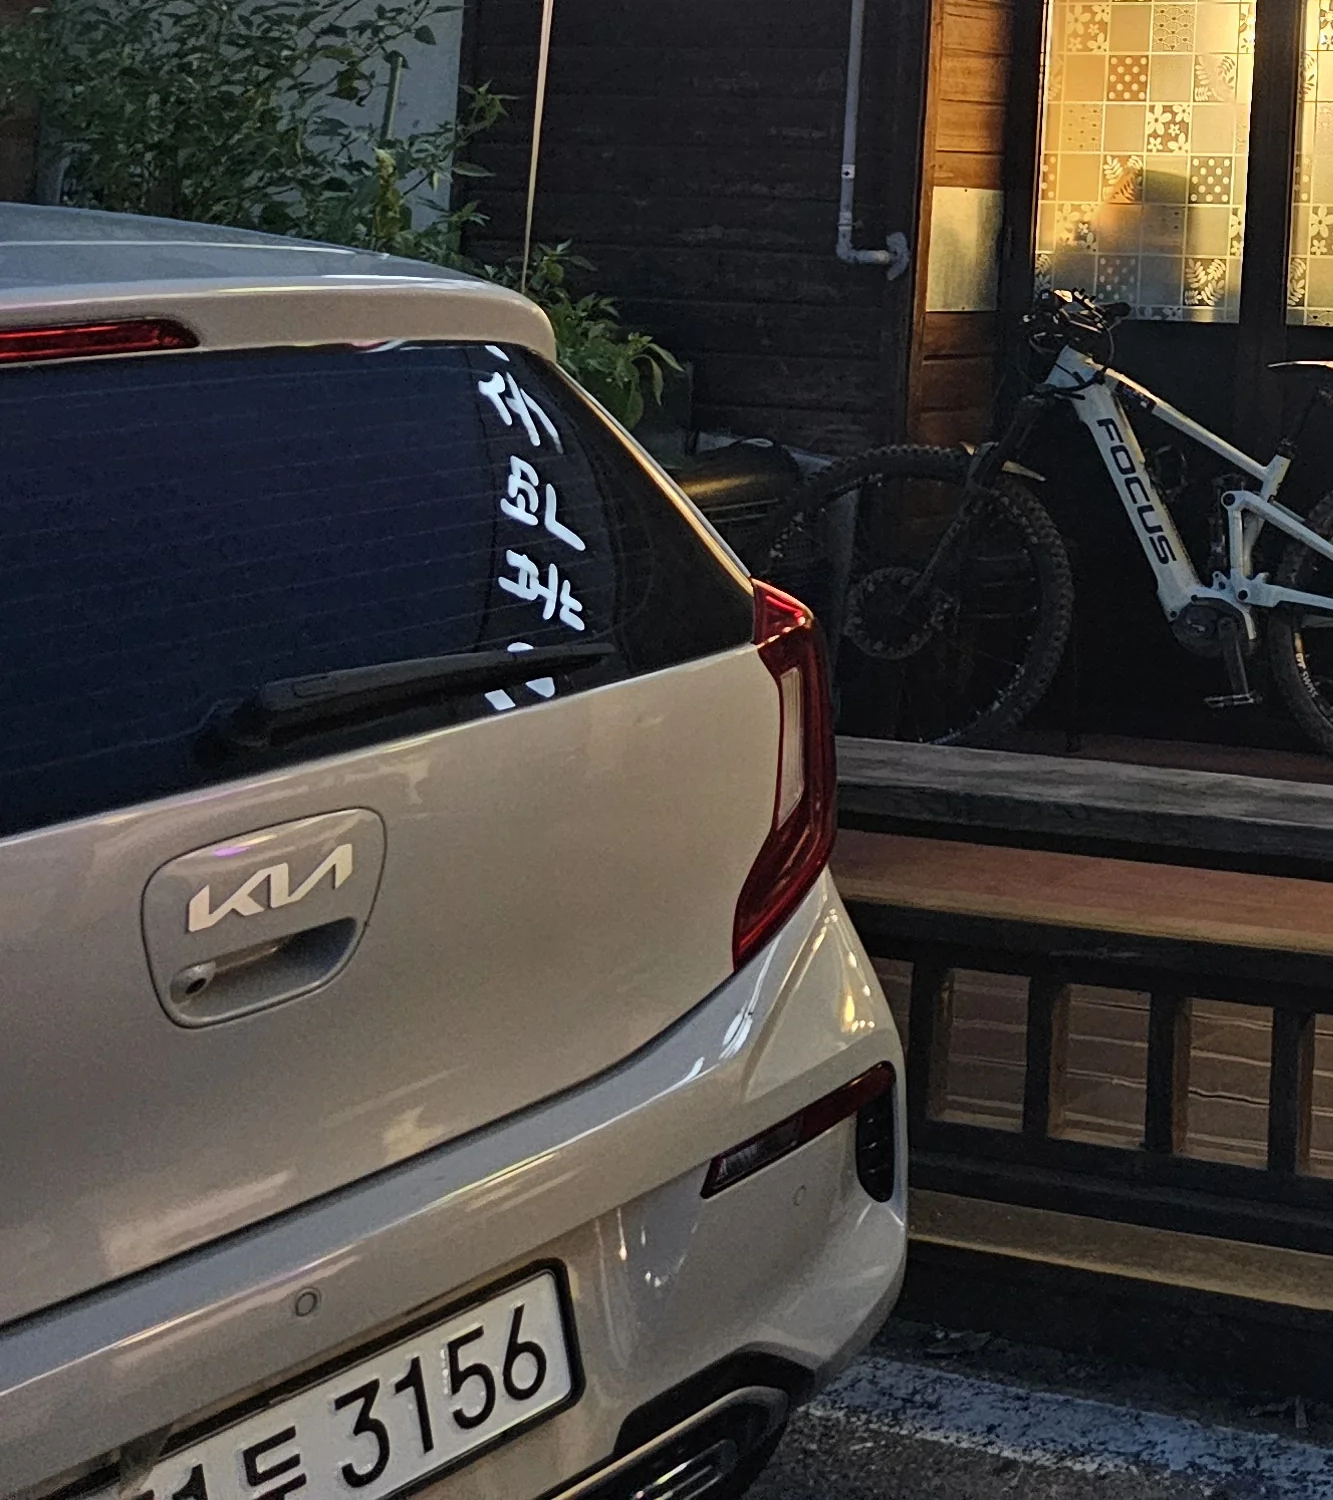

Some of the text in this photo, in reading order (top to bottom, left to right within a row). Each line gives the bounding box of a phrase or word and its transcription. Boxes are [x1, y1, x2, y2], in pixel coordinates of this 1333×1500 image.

[1096, 417, 1178, 565] FOCUS
[187, 843, 353, 933] KIA
[333, 1303, 548, 1489] 3156
